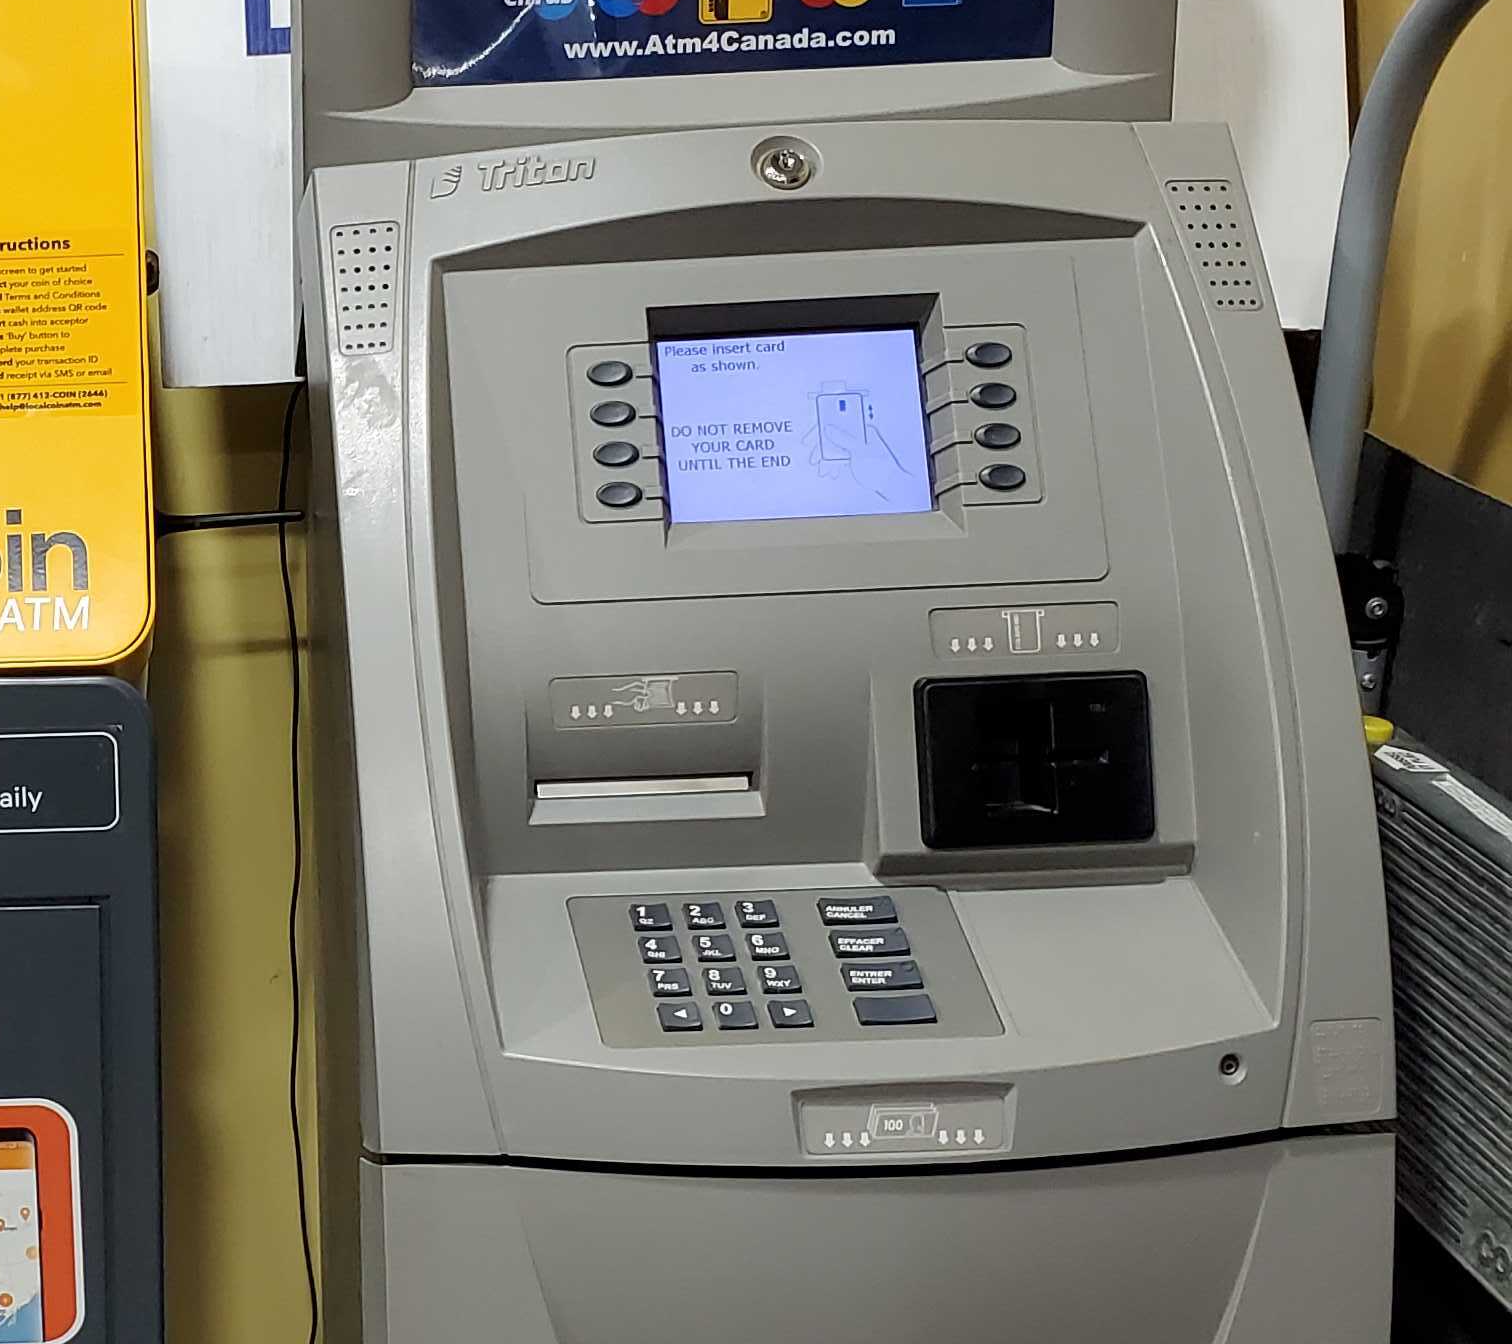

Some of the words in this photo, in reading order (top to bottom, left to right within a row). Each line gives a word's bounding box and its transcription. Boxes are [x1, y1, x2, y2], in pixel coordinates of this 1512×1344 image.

[565, 26, 896, 60] www.Atm4Canada.com
[479, 156, 595, 190] Triton
[664, 343, 707, 358] Please
[712, 341, 750, 355] insert
[755, 339, 785, 354] card
[691, 361, 706, 374] as
[711, 358, 759, 372] shown.
[671, 424, 692, 438] DO
[697, 422, 727, 437] NOT
[731, 420, 792, 435] REMOVE
[692, 439, 731, 454] YOUR
[736, 438, 774, 453] CARD
[678, 457, 721, 472] UNTIL
[726, 455, 754, 470] THE
[758, 454, 790, 468] END
[884, 1120, 903, 1131] 100
